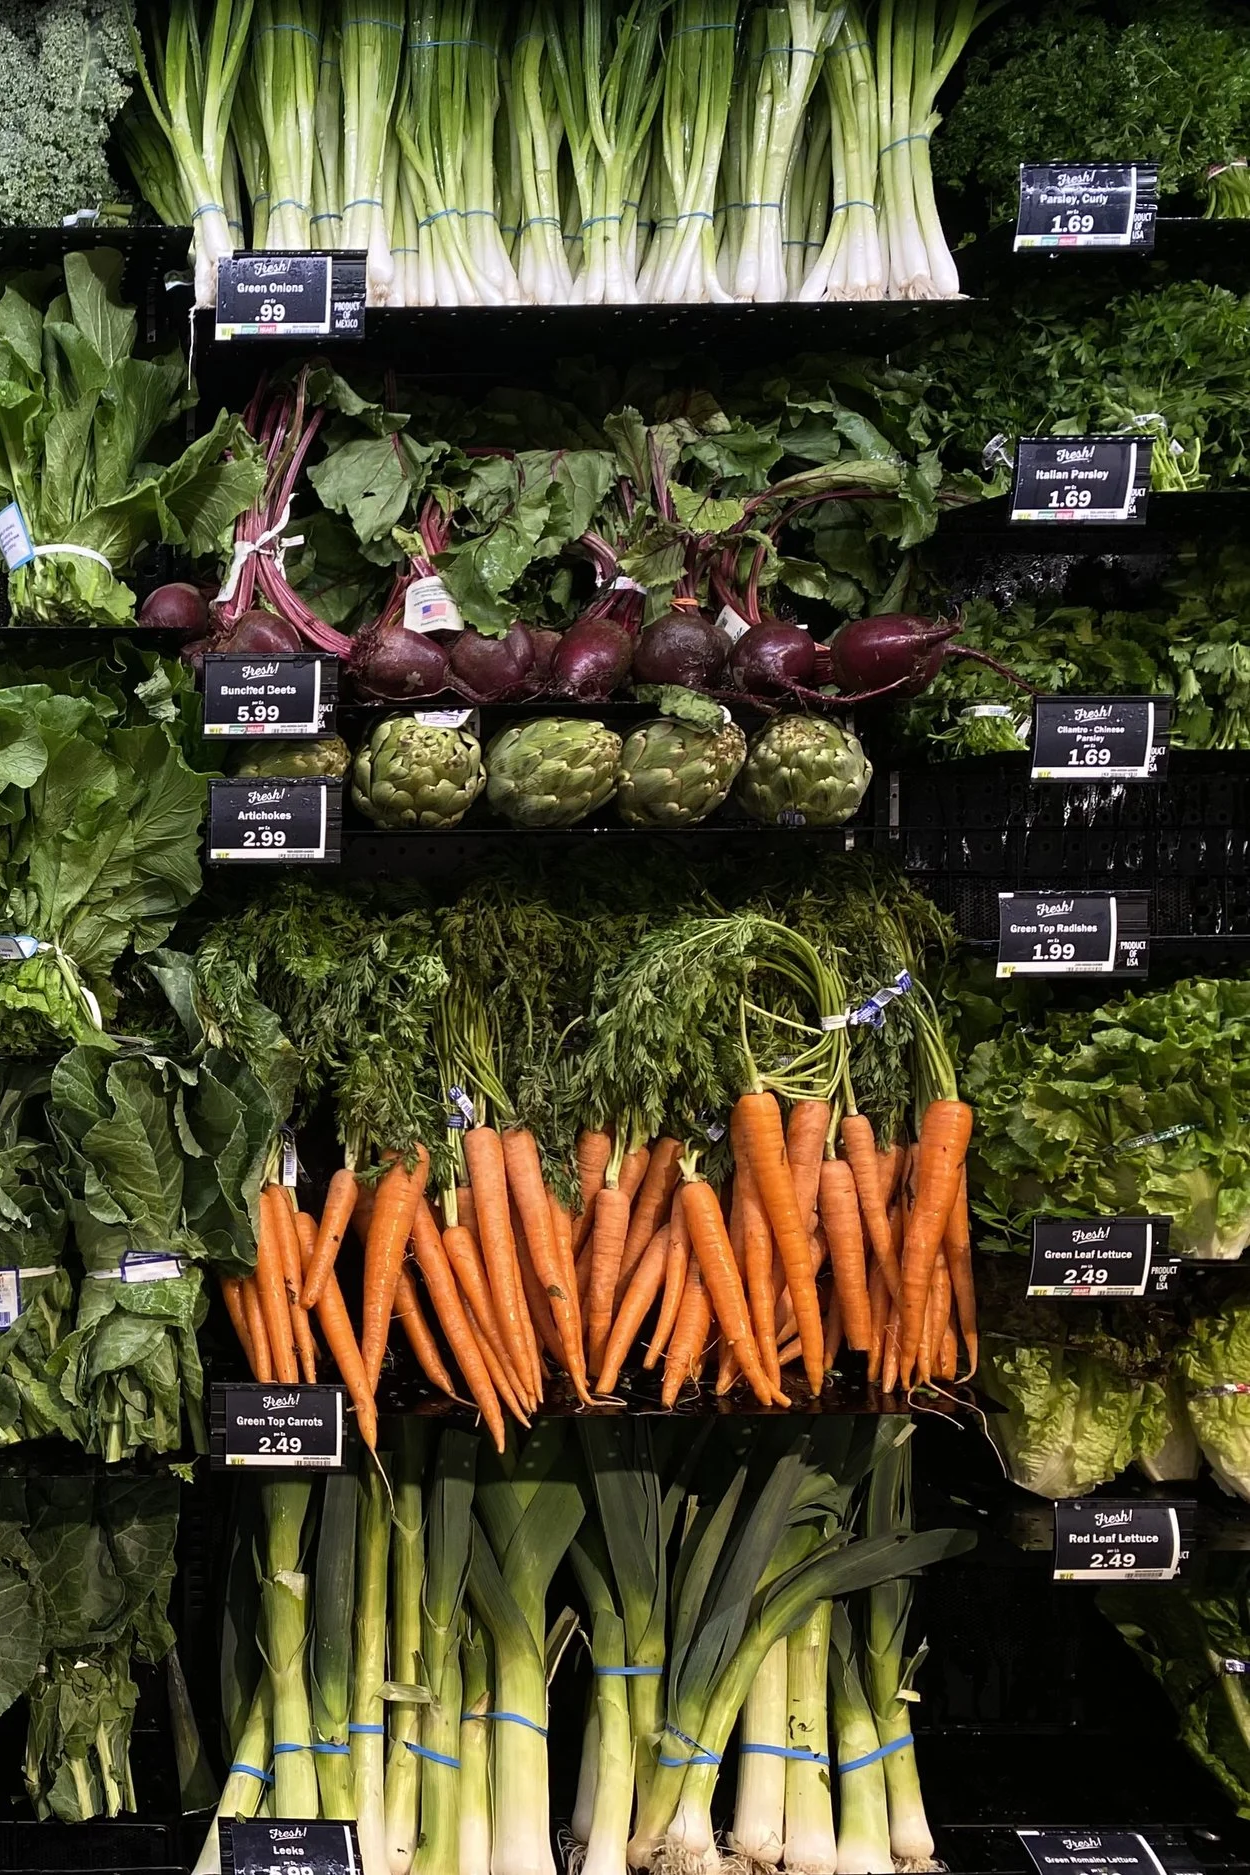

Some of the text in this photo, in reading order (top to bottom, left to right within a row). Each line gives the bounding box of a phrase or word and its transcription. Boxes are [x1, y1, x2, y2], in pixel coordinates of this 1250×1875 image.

[1058, 170, 1096, 188] Fresh!
[1040, 194, 1108, 205] Parsley, Curly
[1134, 213, 1152, 221] ODUCT
[1051, 215, 1094, 233] 1.69
[254, 260, 290, 277] Fresh!
[237, 283, 304, 293] Green Onions
[334, 302, 360, 311] PRODUCT
[255, 304, 285, 322] .99
[335, 319, 358, 328] MEXICO
[1057, 446, 1095, 464] Fresh!
[1036, 470, 1109, 480] Italian Parsley
[1131, 488, 1146, 496] DUCT
[1049, 490, 1091, 507] 1.69
[1129, 505, 1137, 514] SA
[242, 662, 279, 680] Fresh!
[237, 706, 279, 722] 5.99
[319, 704, 333, 712] DUCT
[1074, 705, 1112, 723] Fresh!
[1076, 735, 1104, 743] Parsley
[1068, 749, 1111, 765] 1.69
[1151, 747, 1166, 755] DUCT
[248, 788, 285, 806] Fresh!
[238, 811, 292, 820] Artichokes
[243, 831, 286, 847] 2.99
[1036, 900, 1074, 918] Fresh!
[1010, 924, 1098, 934] Green Top Radishes
[1032, 944, 1075, 960] 1.99
[1120, 942, 1146, 950] PRODUCT
[1126, 958, 1138, 966] USA
[1072, 1226, 1110, 1244] Fresh!
[1045, 1250, 1132, 1259] Green Leaf Lettuce
[1063, 1269, 1108, 1284] 2.49
[1156, 1282, 1168, 1290] USA
[263, 1393, 300, 1411] Fresh!
[237, 1416, 323, 1428] Green Top Carrots
[259, 1437, 302, 1453] 2.49
[1094, 1509, 1132, 1528] Fresh!
[1069, 1534, 1159, 1543] Red Leaf Lettuce
[1090, 1554, 1136, 1568] 2.49
[269, 1827, 307, 1841] Fresh!
[273, 1846, 304, 1855] Leeks
[1063, 1838, 1102, 1851] Fresh!
[1108, 1856, 1138, 1864] Lettuce
[269, 1866, 314, 1875] 599
